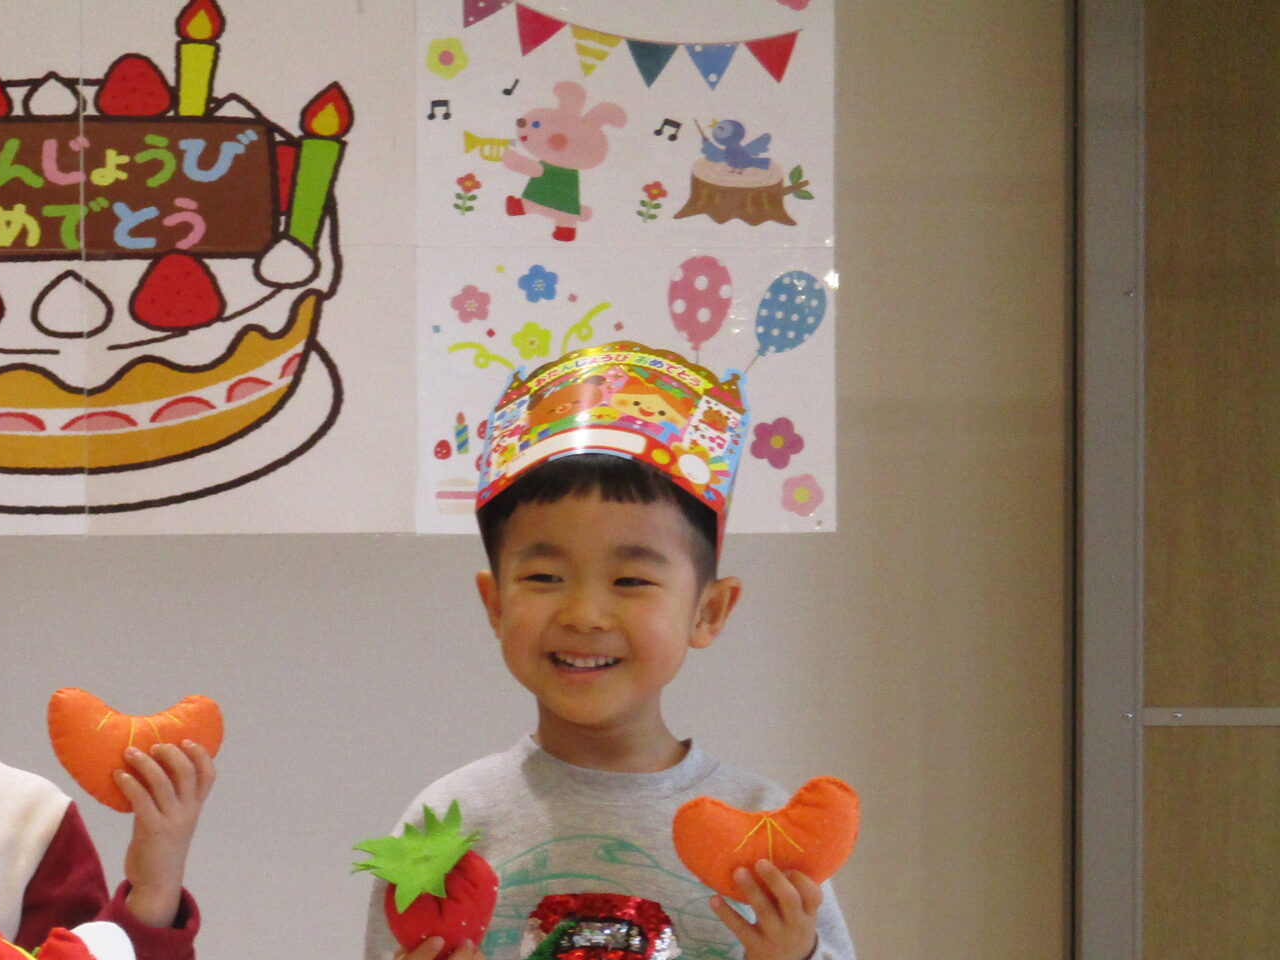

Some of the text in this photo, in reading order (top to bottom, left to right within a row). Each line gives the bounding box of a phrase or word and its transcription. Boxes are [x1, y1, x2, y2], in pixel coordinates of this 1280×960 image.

[534, 352, 703, 388] おたんじょうび おめでとう
